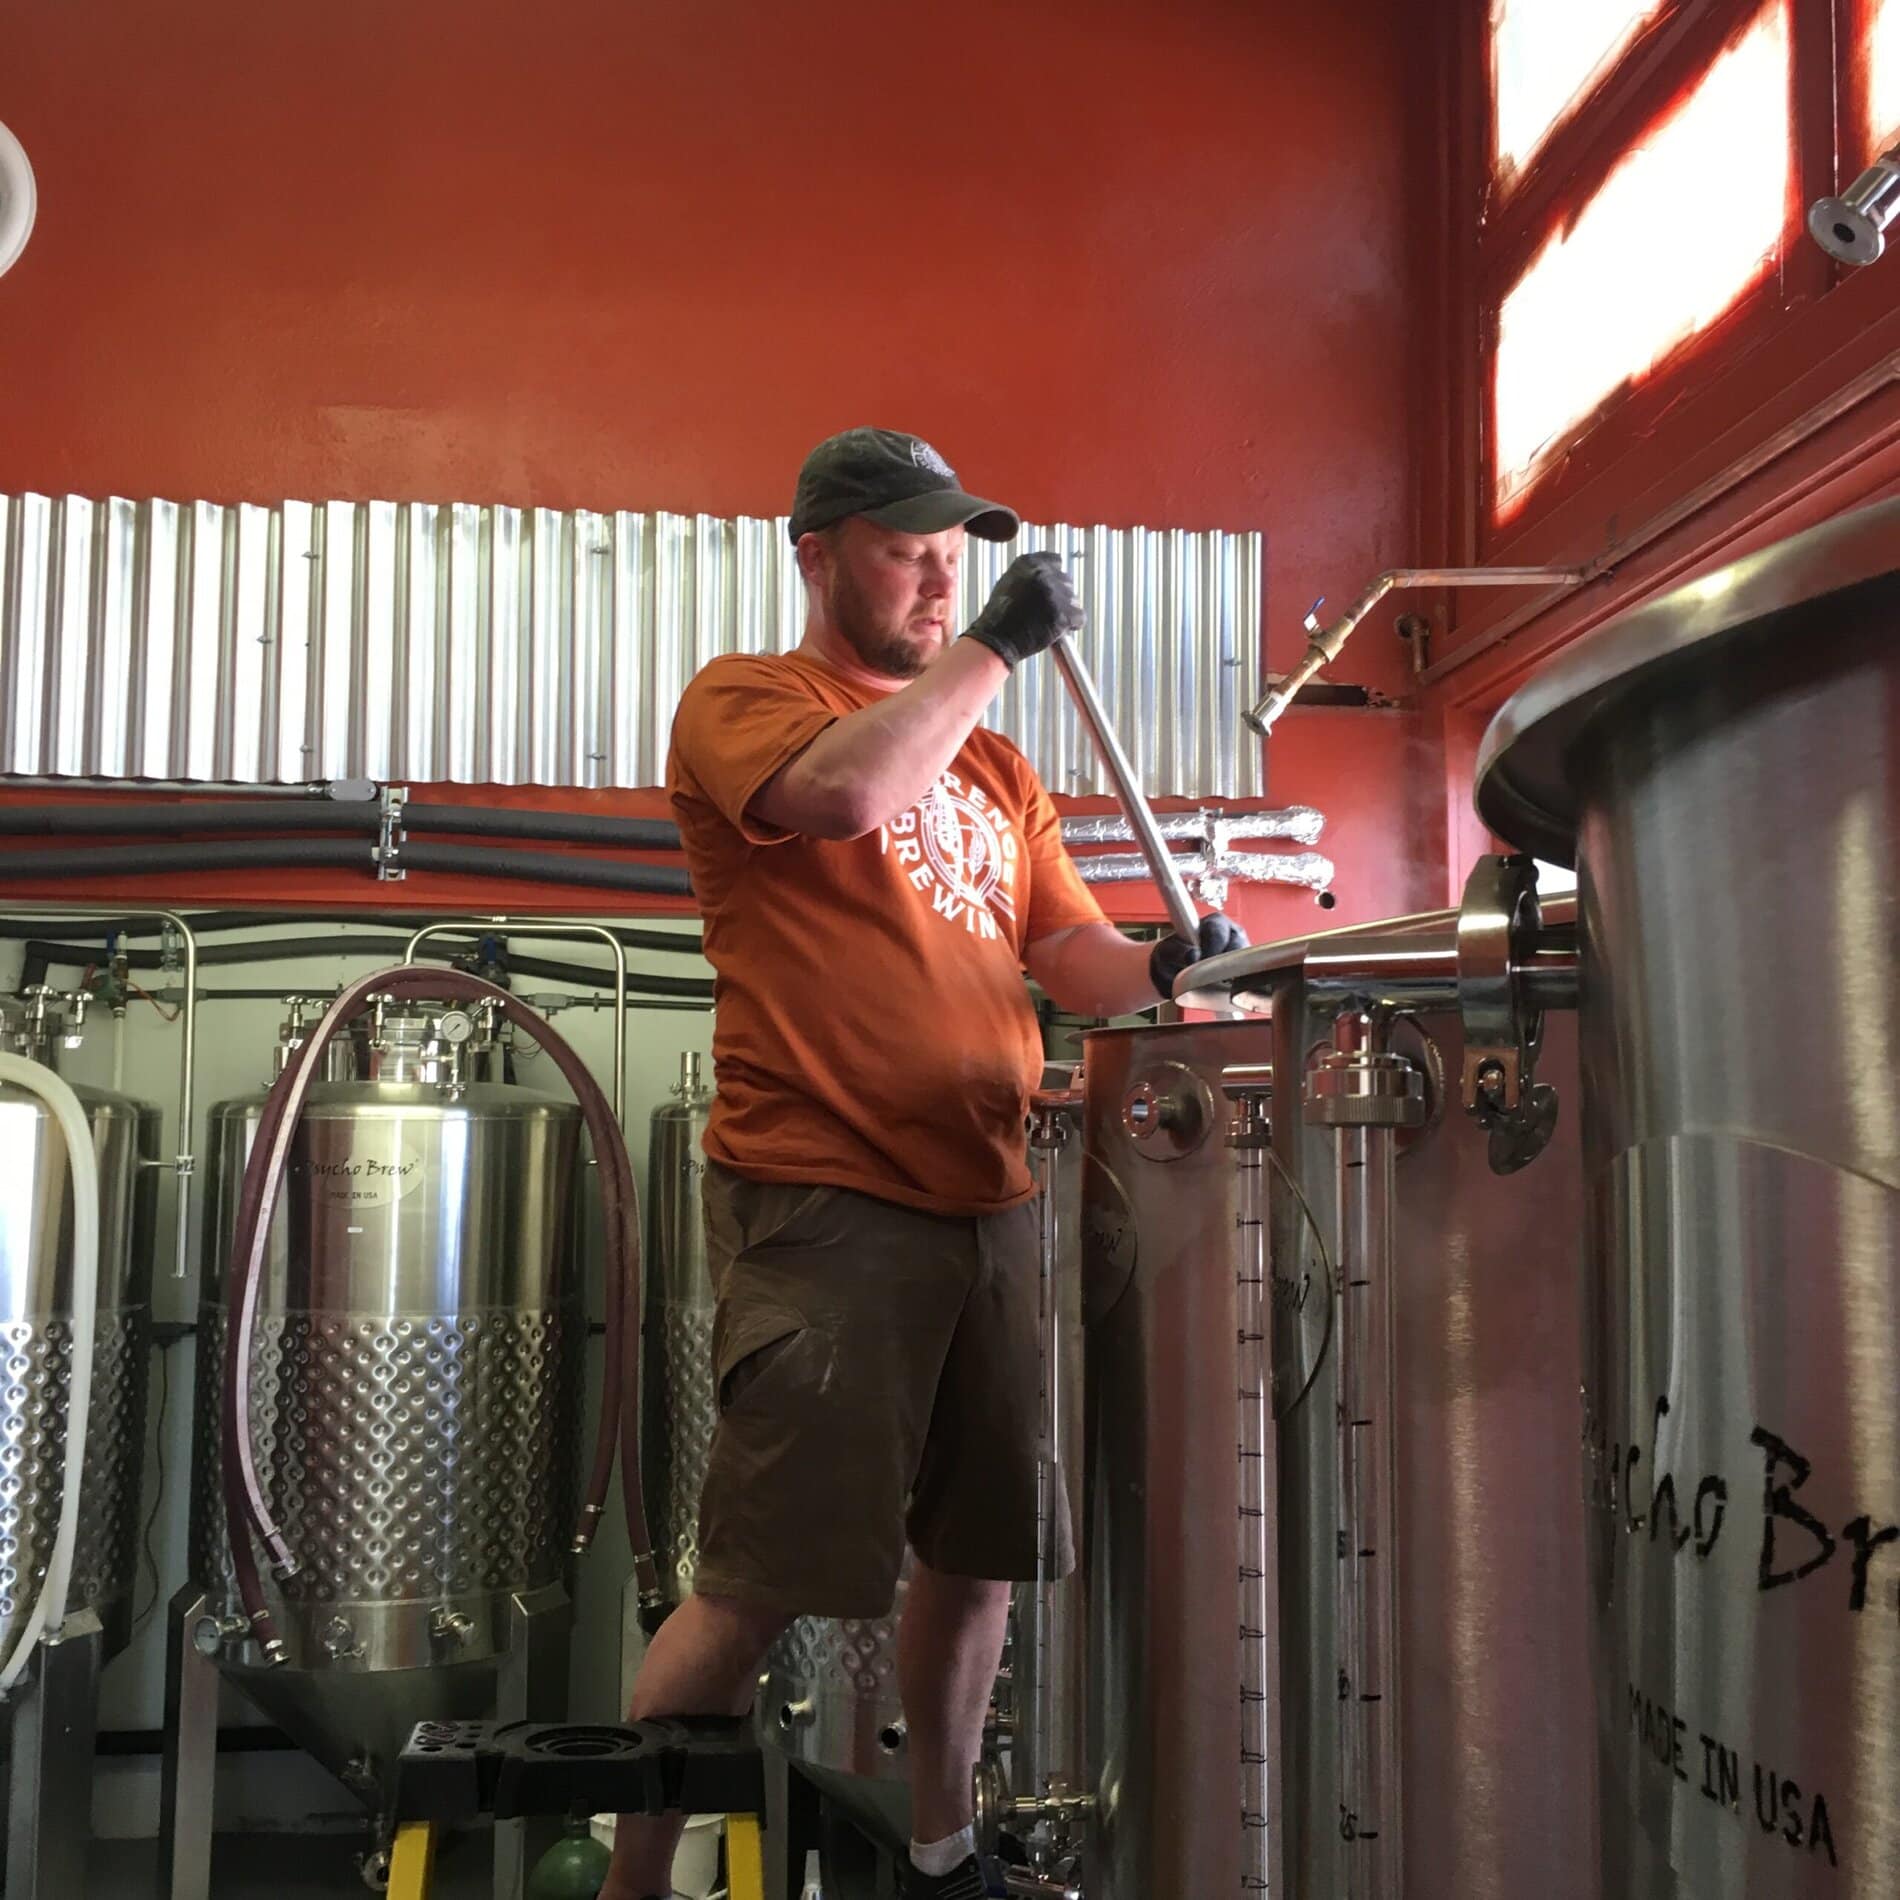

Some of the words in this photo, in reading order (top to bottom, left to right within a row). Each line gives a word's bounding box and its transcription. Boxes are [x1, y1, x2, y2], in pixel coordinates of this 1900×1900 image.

[890, 811, 997, 940] BREWIN
[366, 1158, 415, 1177] Brew
[1750, 1425, 1900, 1612] Br
[1698, 1732, 1742, 1813] IN
[1752, 1760, 1840, 1868] USA
